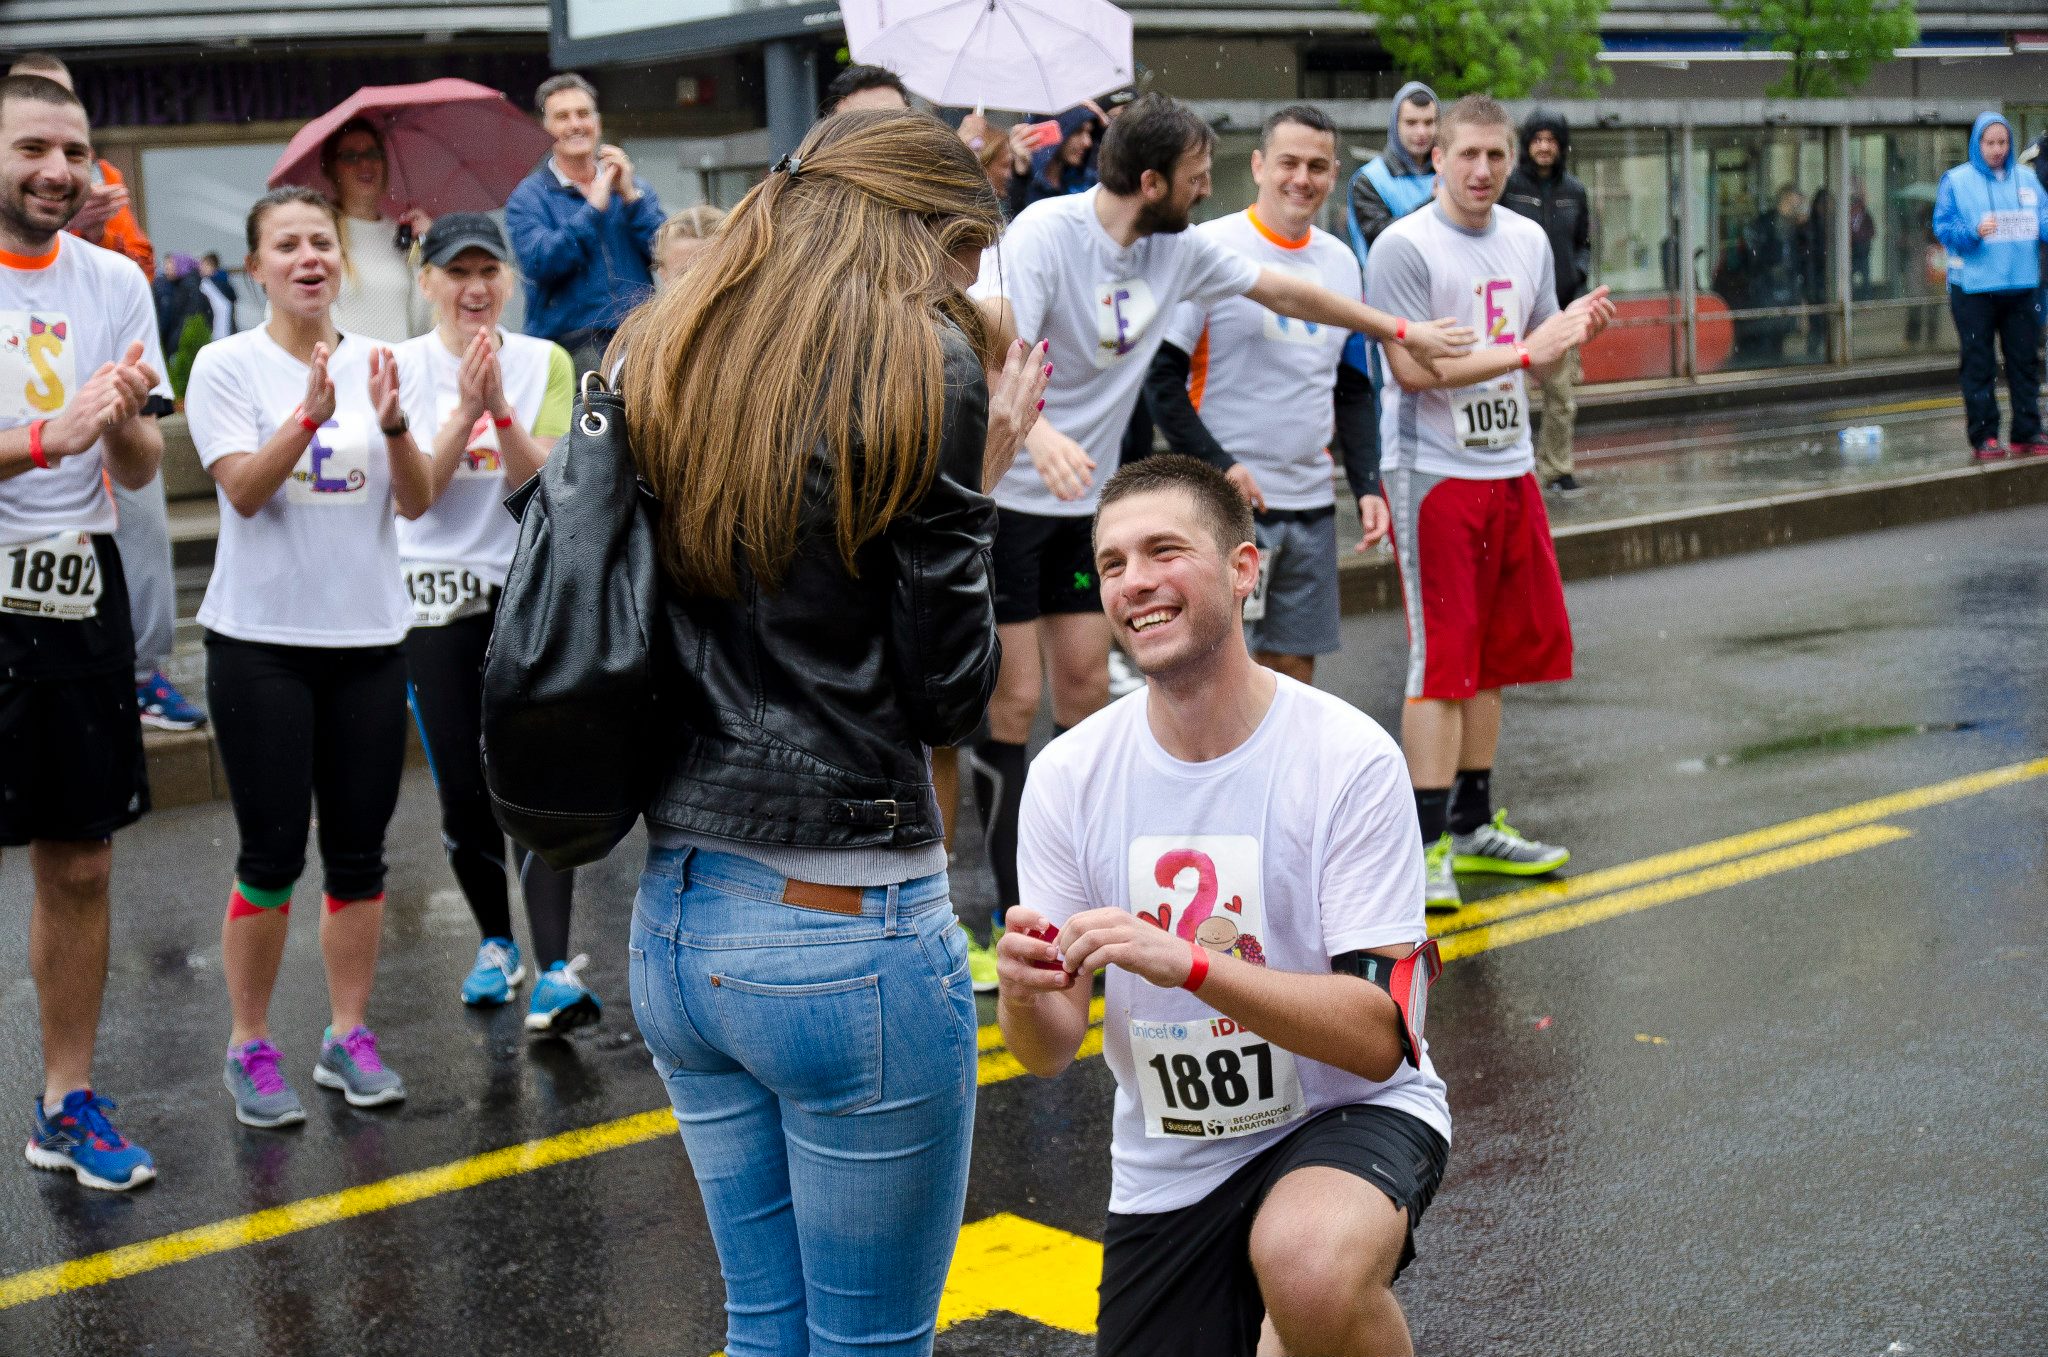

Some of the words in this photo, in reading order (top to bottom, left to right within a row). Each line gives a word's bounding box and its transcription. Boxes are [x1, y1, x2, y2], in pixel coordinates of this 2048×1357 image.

[1486, 281, 1515, 344] E
[24, 333, 63, 412] S
[1462, 399, 1519, 433] 1052
[8, 549, 96, 595] 1892
[1132, 1023, 1168, 1039] unicef
[1149, 1042, 1274, 1111] 1887
[1229, 1117, 1275, 1133] MARATON
[1232, 1104, 1291, 1125] BEOGRADSKI
